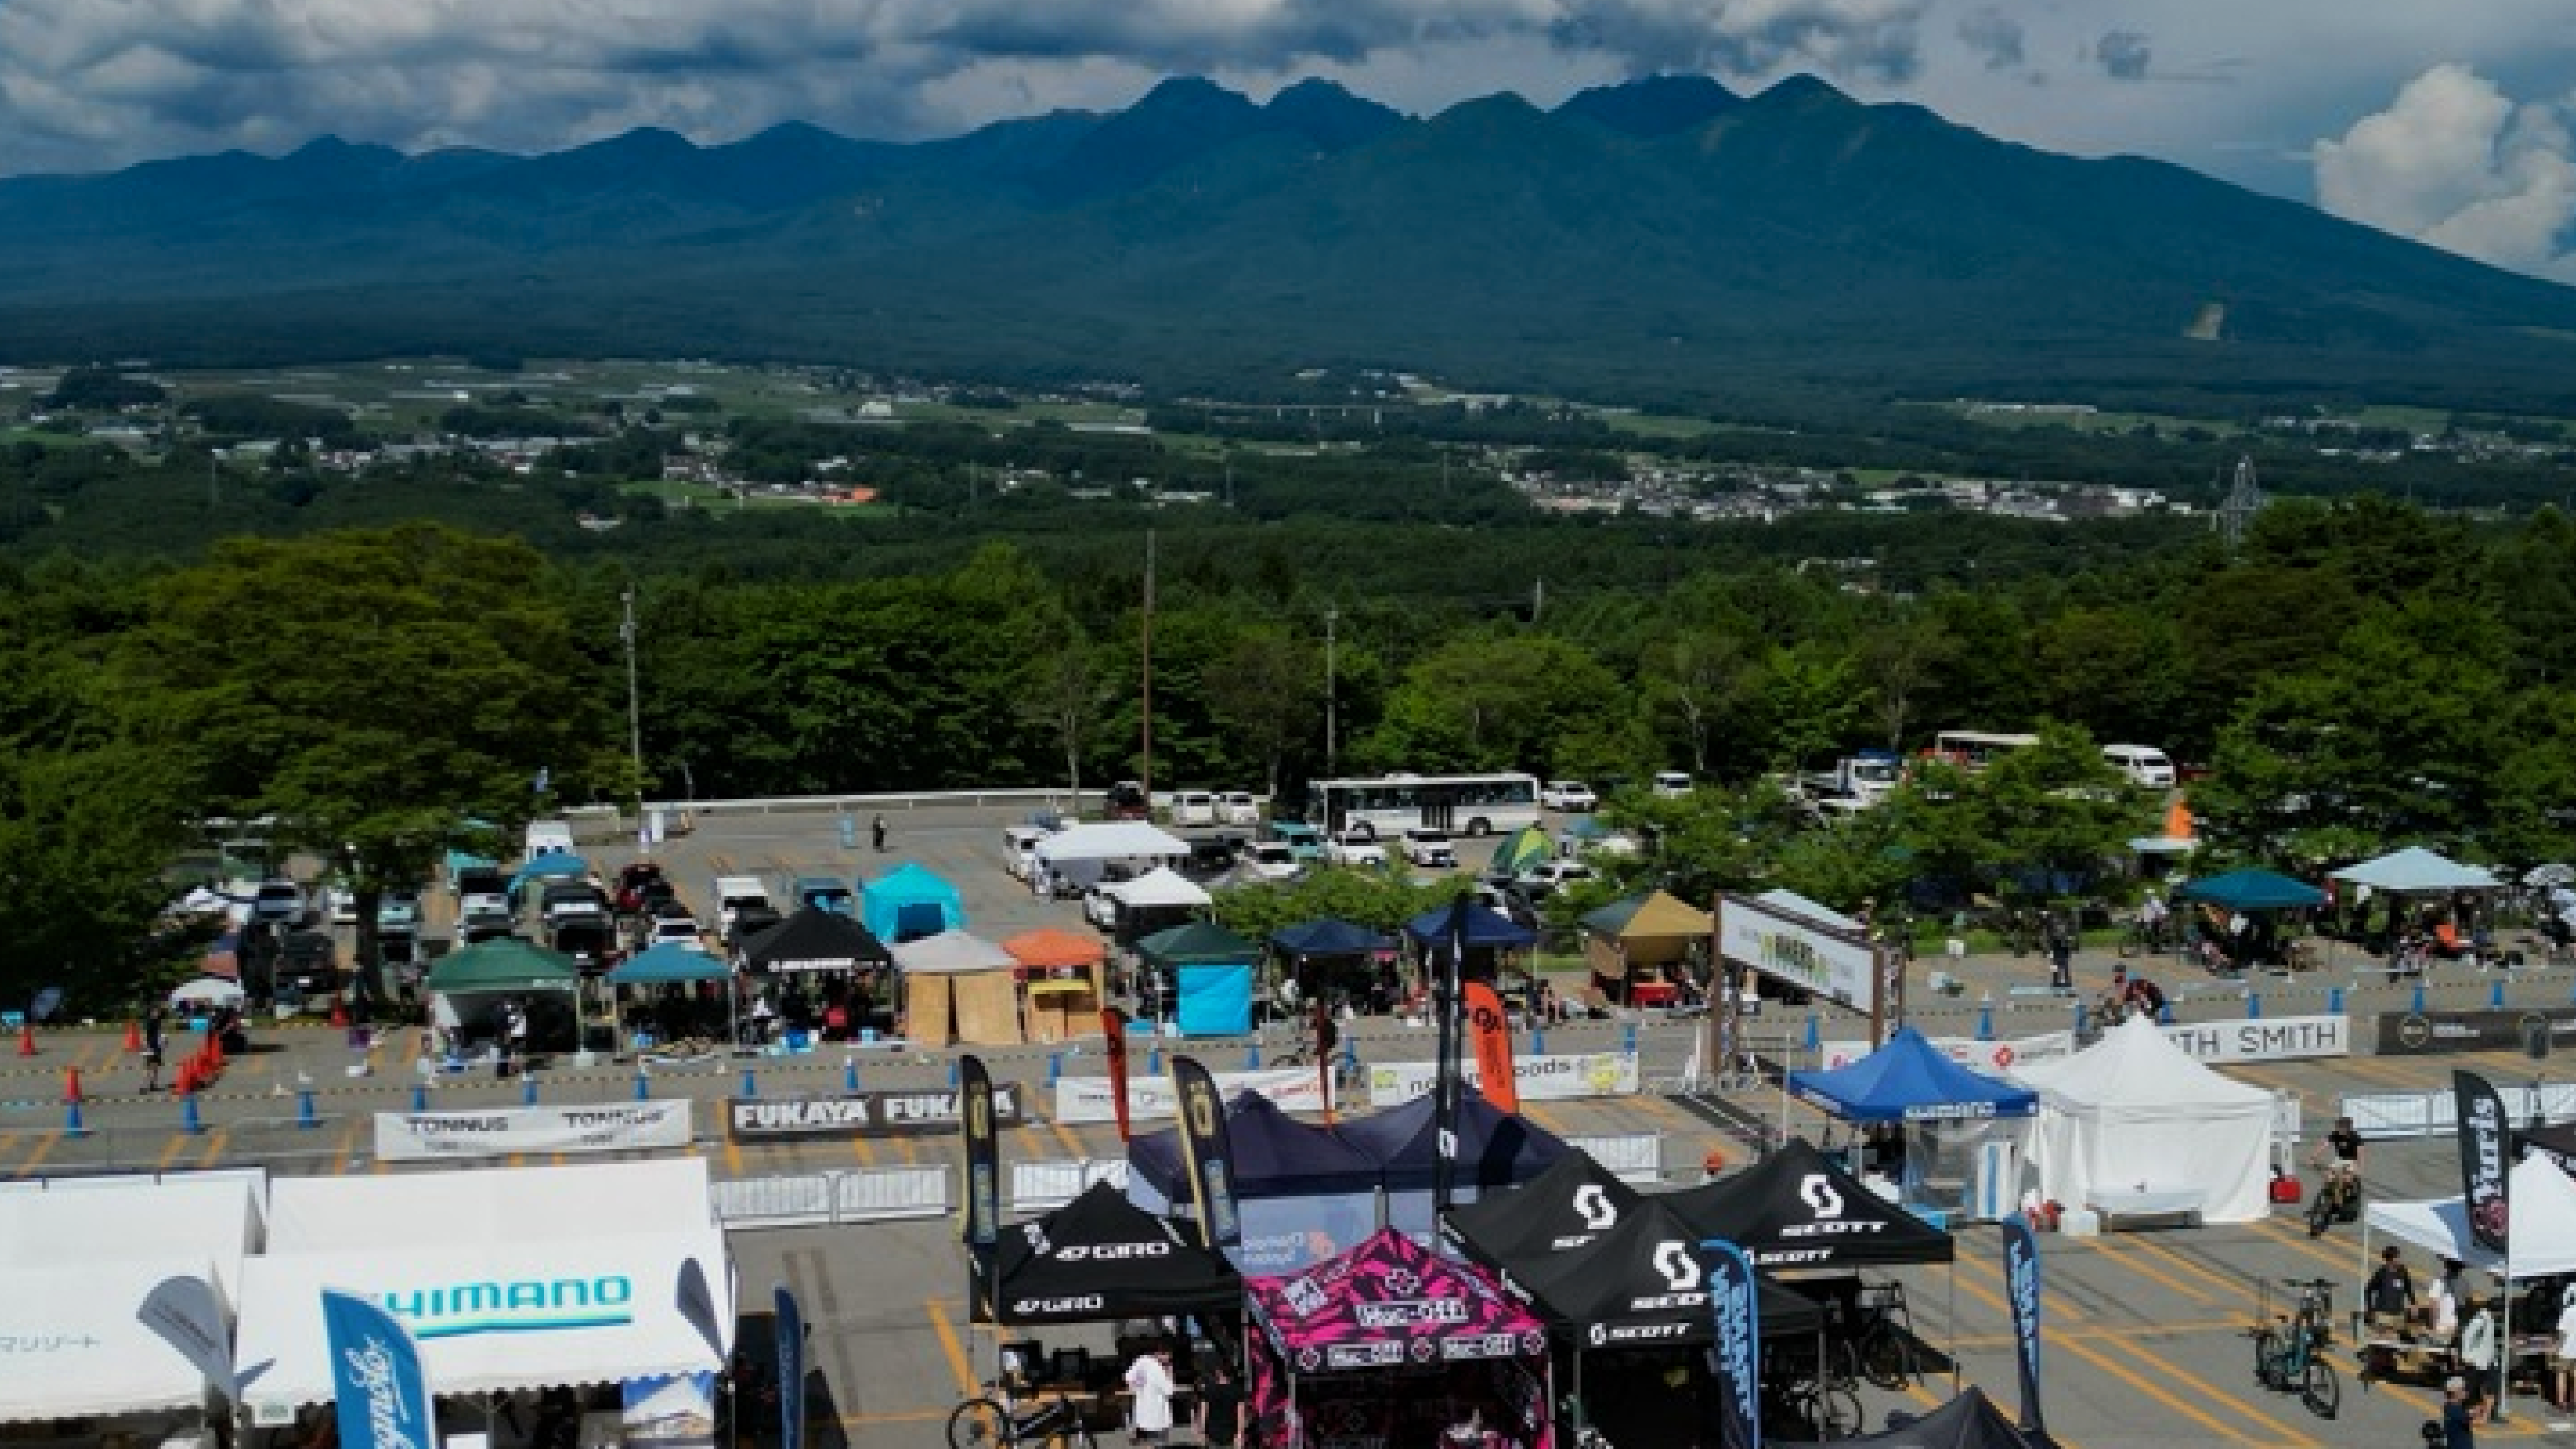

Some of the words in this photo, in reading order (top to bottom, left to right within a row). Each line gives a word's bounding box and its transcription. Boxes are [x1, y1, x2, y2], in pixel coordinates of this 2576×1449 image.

[2238, 1022, 2337, 1053] SMITH
[735, 1099, 869, 1128] FUKAYA
[1780, 1221, 1888, 1239] SCOTT
[1759, 1247, 1834, 1264] SCOTT
[384, 1276, 632, 1316] HIMANO
[1609, 1324, 1693, 1340] SCOTT
